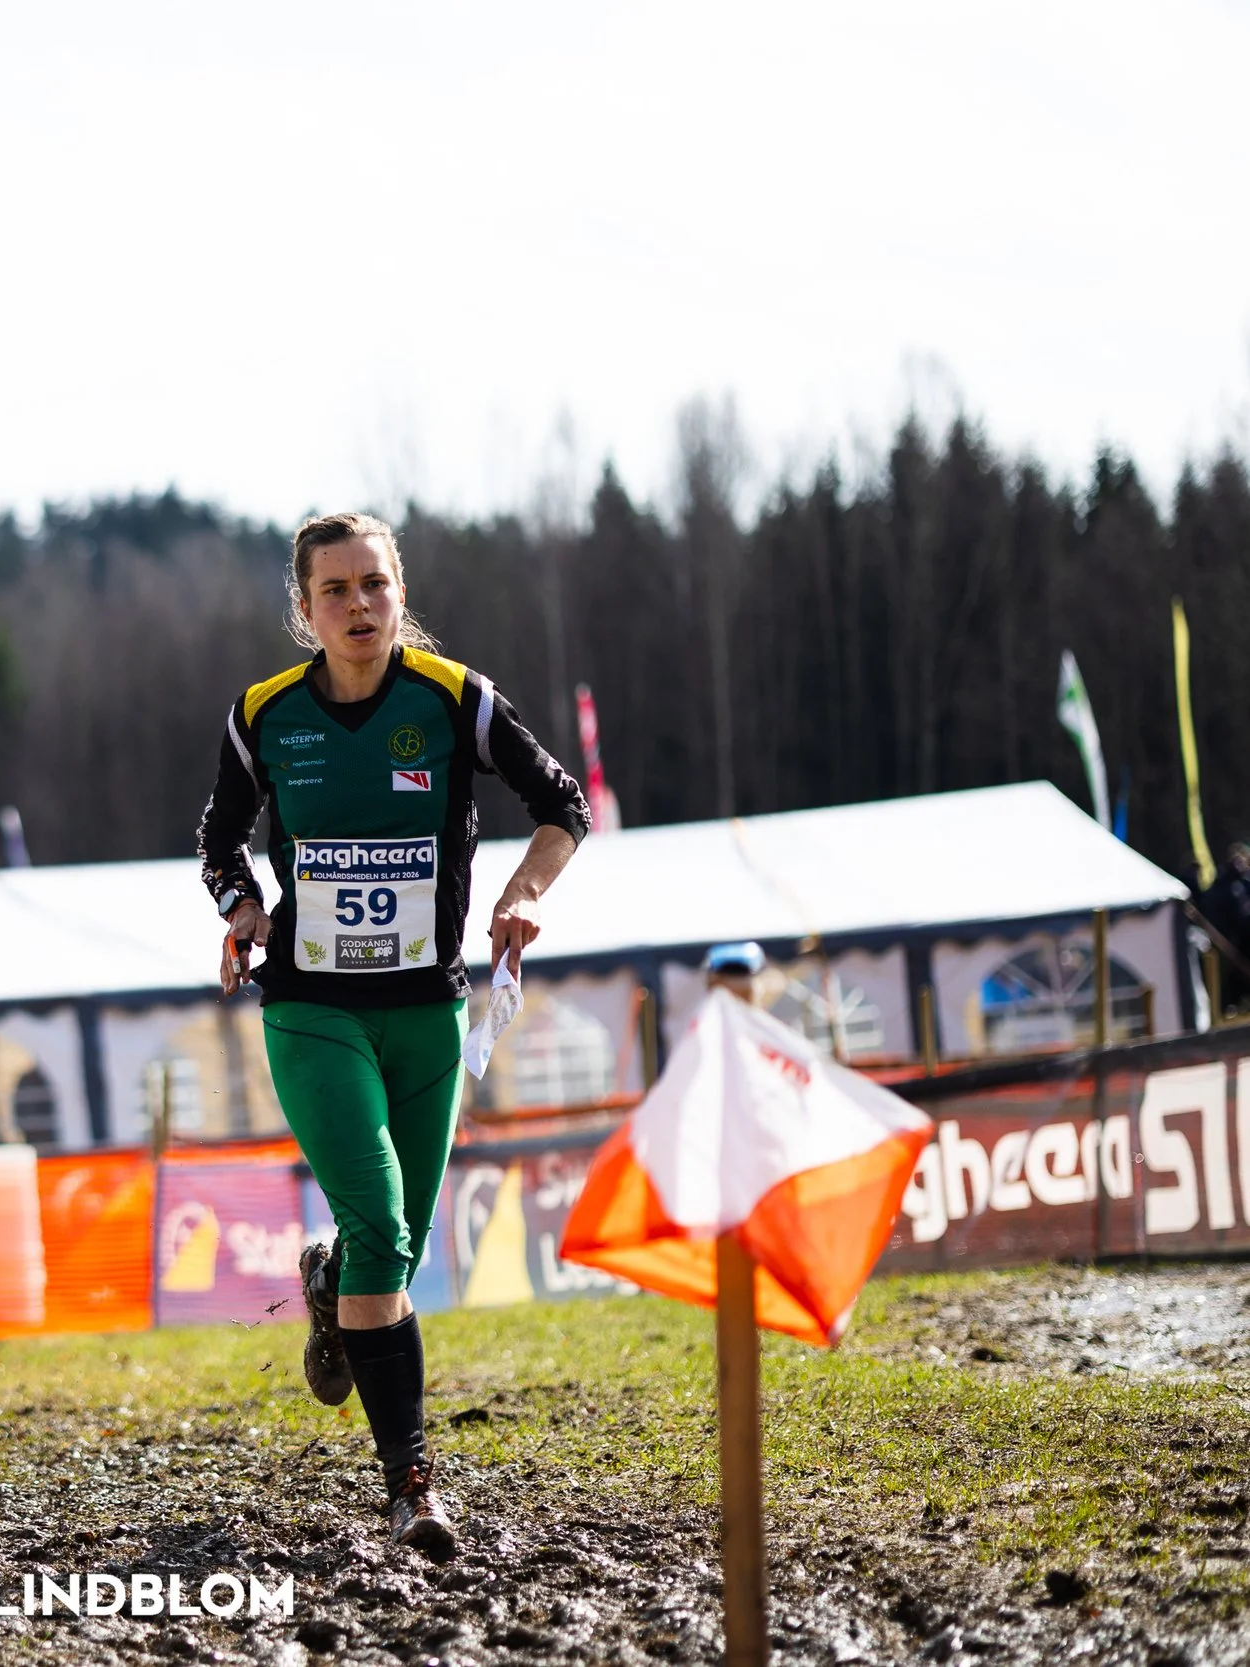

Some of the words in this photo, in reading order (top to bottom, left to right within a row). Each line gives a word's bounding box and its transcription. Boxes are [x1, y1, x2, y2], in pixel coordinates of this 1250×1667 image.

[300, 844, 433, 869] bagheera
[312, 871, 379, 880] KOLMÅRDSMEDELN
[381, 872, 389, 880] SL
[402, 871, 420, 879] 2026
[335, 887, 398, 927] 59
[340, 938, 394, 948] GODKÄNDA
